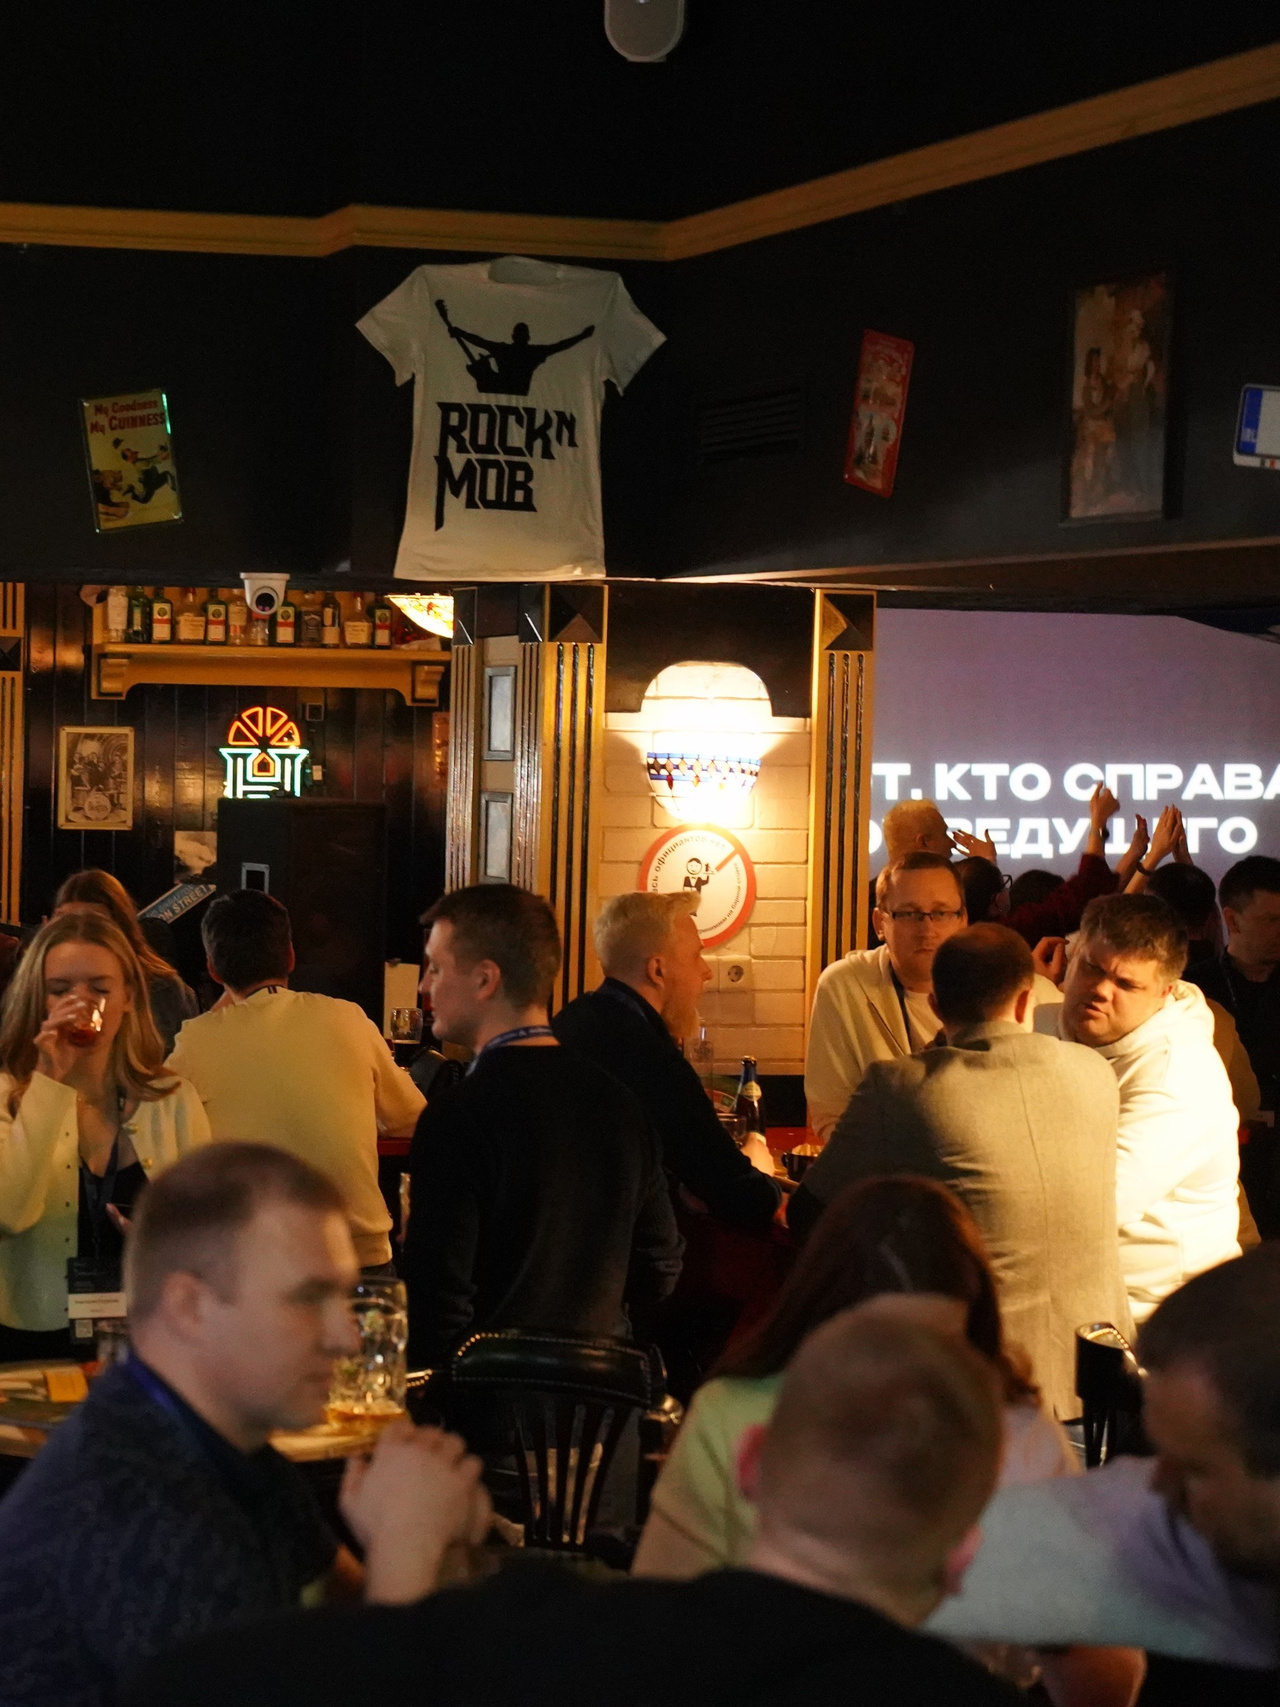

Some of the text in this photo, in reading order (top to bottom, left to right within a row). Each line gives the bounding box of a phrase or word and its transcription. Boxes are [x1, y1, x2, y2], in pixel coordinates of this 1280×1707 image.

[108, 412, 166, 432] GUINNESS
[433, 455, 538, 532] MOB
[935, 762, 1052, 801] КТО
[172, 884, 208, 914] STREET
